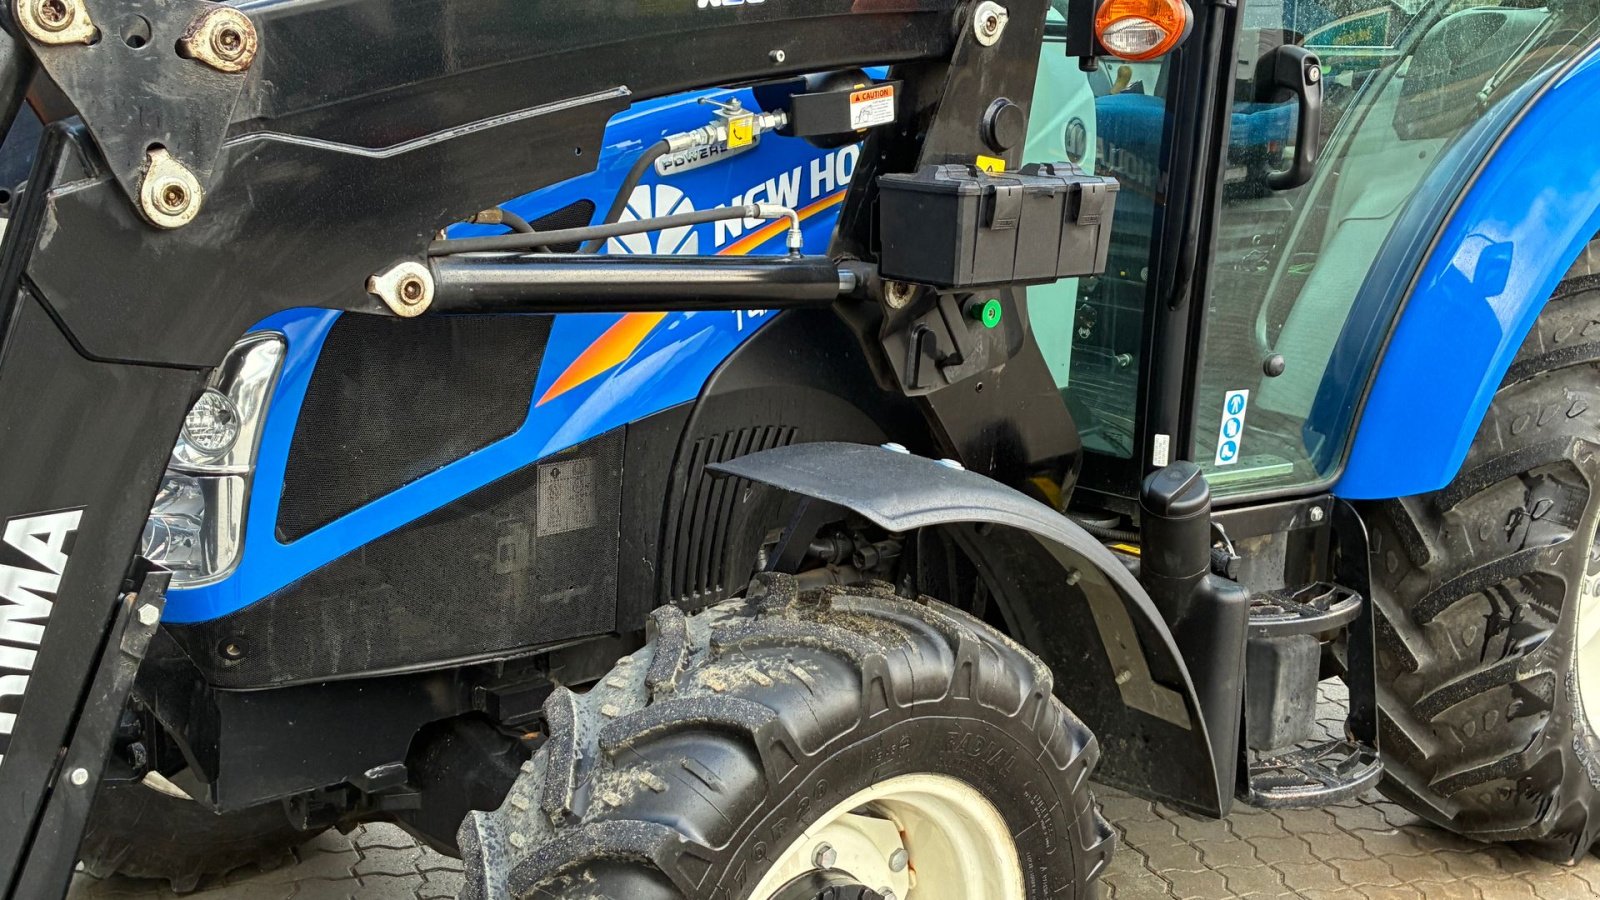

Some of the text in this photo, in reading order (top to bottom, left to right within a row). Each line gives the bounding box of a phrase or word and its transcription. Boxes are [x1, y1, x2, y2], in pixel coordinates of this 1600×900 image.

[862, 89, 889, 100] CAUTION
[714, 140, 864, 247] NEW HO
